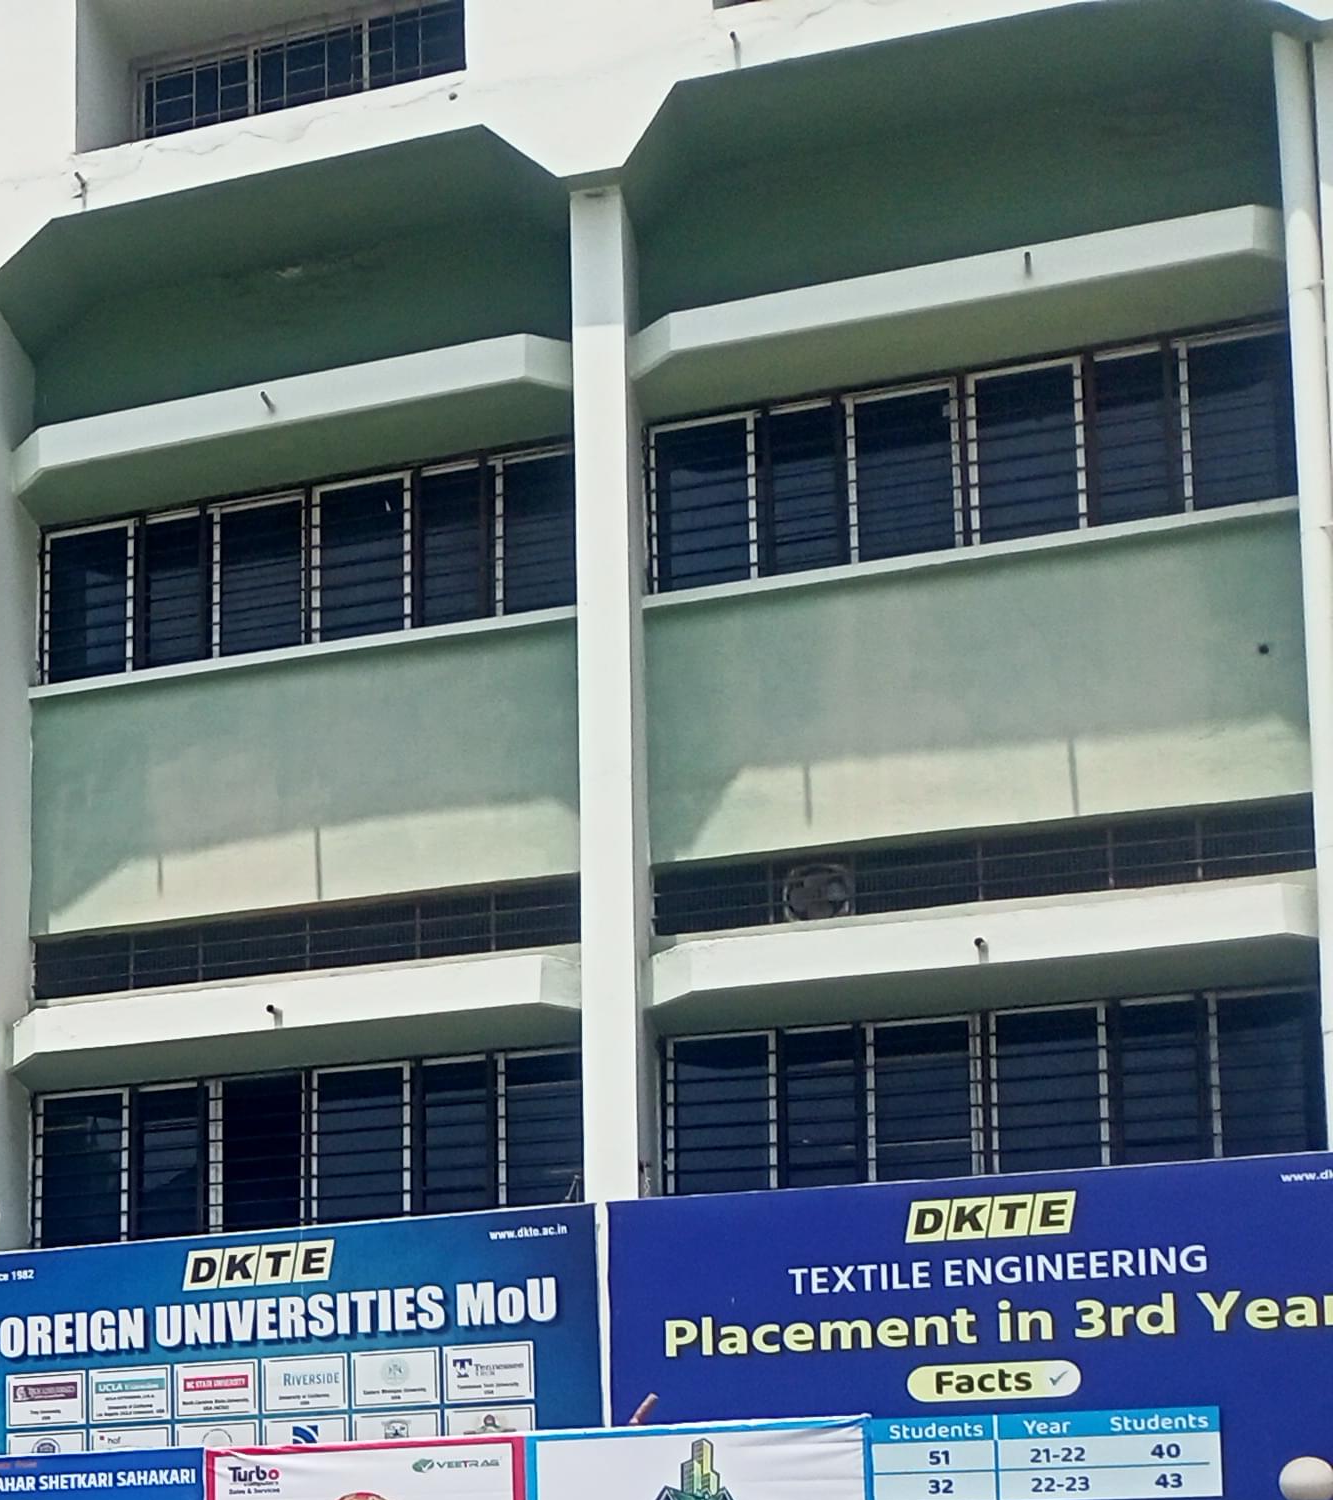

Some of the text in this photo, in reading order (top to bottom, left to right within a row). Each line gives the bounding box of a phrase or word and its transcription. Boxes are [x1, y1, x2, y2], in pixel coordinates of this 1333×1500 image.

[915, 1196, 1068, 1238] DKTE
[12, 1269, 34, 1280] 1982
[192, 1245, 327, 1282] DKTE
[789, 1245, 1208, 1295] TEXTILE ENGINEERING
[157, 1289, 445, 1348] UNIVERSITIES
[457, 1278, 557, 1328] MoU
[664, 1306, 977, 1357] Placement
[999, 1301, 1053, 1343] in
[1075, 1293, 1175, 1338] 3rd
[935, 1367, 1032, 1395] Facts
[890, 1412, 1208, 1440] Students Year Students
[928, 1443, 1180, 1465] 51 21-22 40
[39, 1472, 112, 1490] SHETKARI
[117, 1469, 195, 1487] SAHAKARI
[228, 1467, 280, 1482] Turbo
[928, 1473, 1182, 1495] 32 22-23 43
